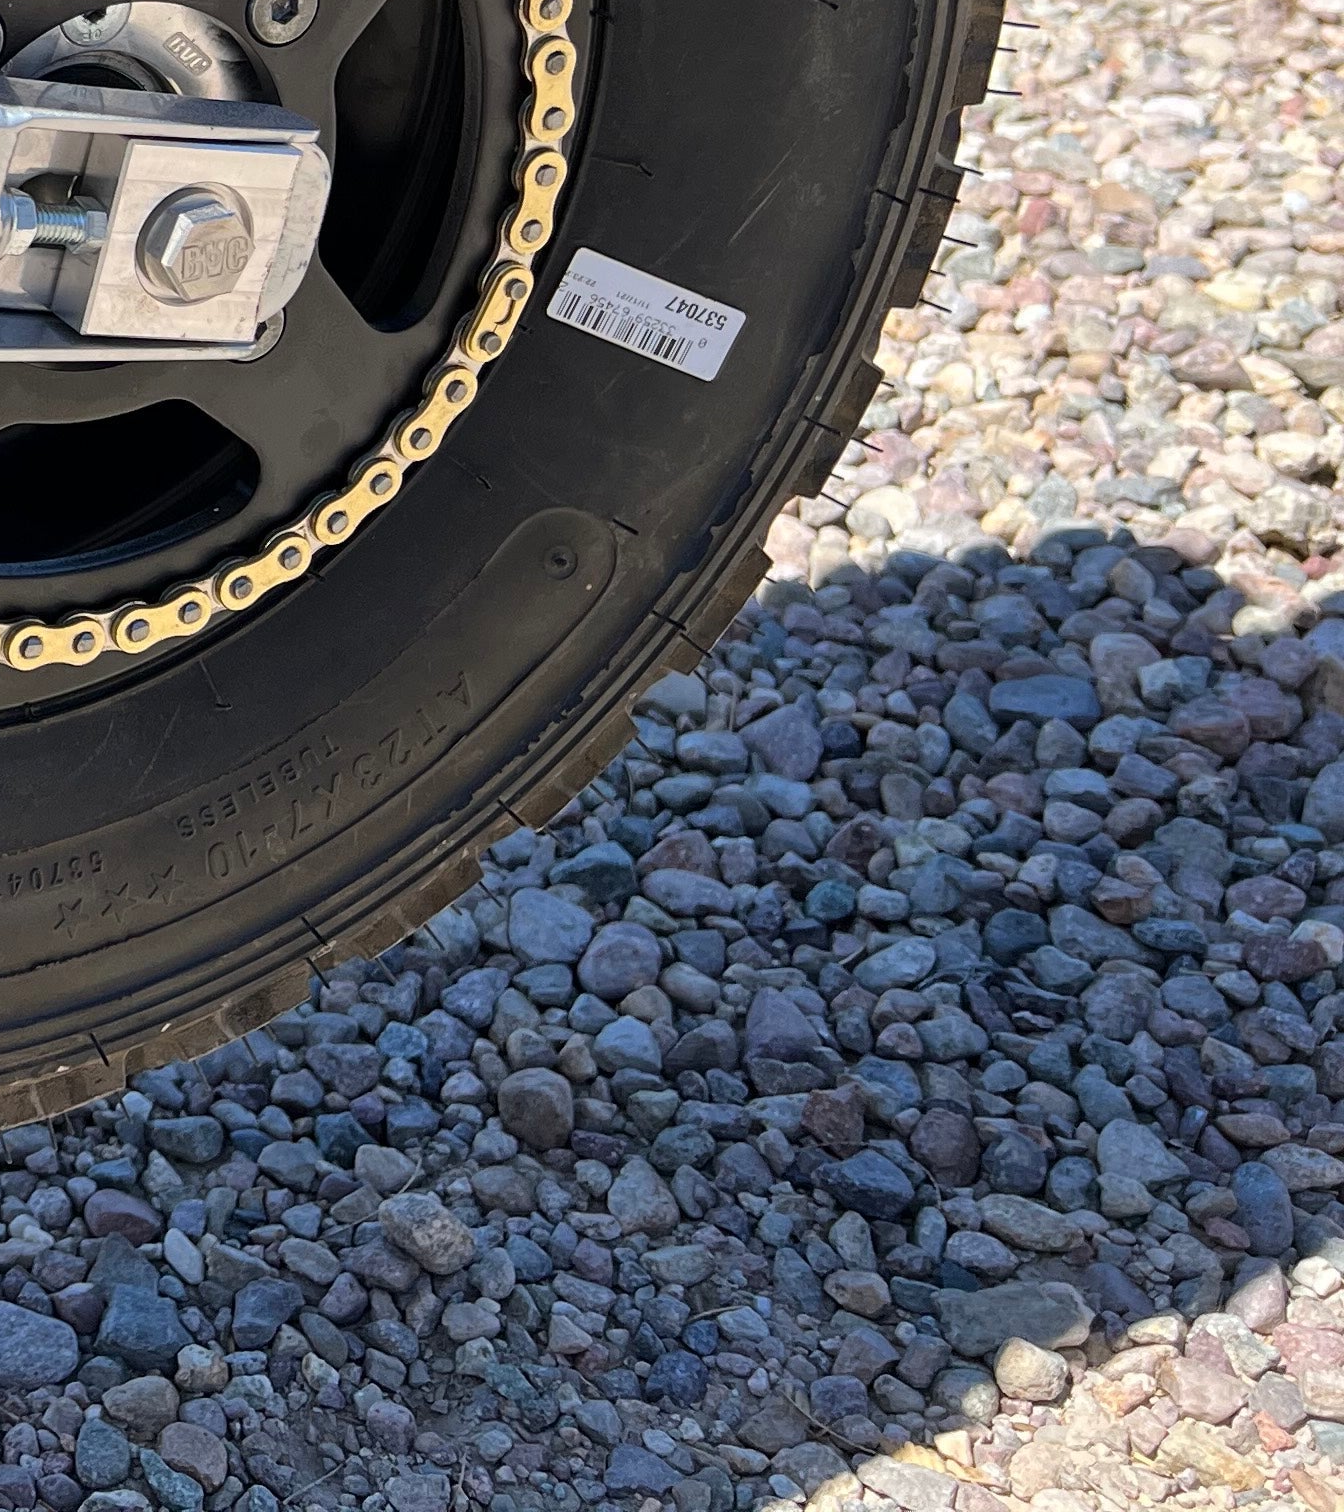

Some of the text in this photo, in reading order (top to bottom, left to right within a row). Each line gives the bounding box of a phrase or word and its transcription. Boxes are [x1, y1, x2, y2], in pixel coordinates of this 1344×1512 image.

[169, 38, 208, 74] BVC
[181, 236, 248, 283] BVC
[590, 293, 630, 317] 67456
[665, 296, 728, 332] 537047
[635, 312, 677, 337] 33259
[174, 733, 342, 840] TUBELESS
